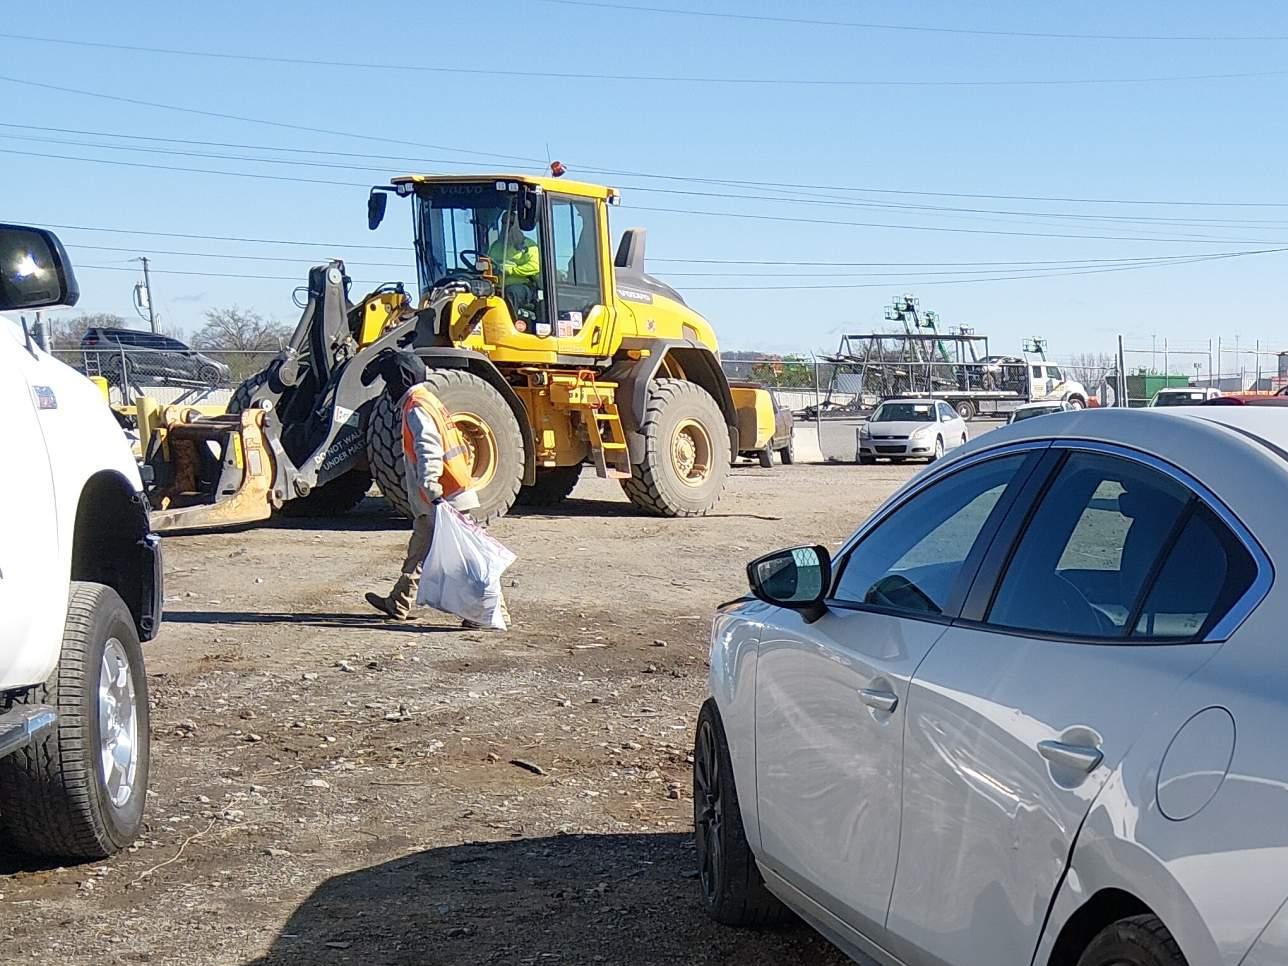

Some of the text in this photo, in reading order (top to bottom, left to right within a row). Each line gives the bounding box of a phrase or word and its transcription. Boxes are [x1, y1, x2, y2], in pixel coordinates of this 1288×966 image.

[616, 288, 651, 302] VOLVO
[313, 451, 327, 465] DO
[327, 440, 344, 457] NOT
[322, 451, 349, 471] UNDER
